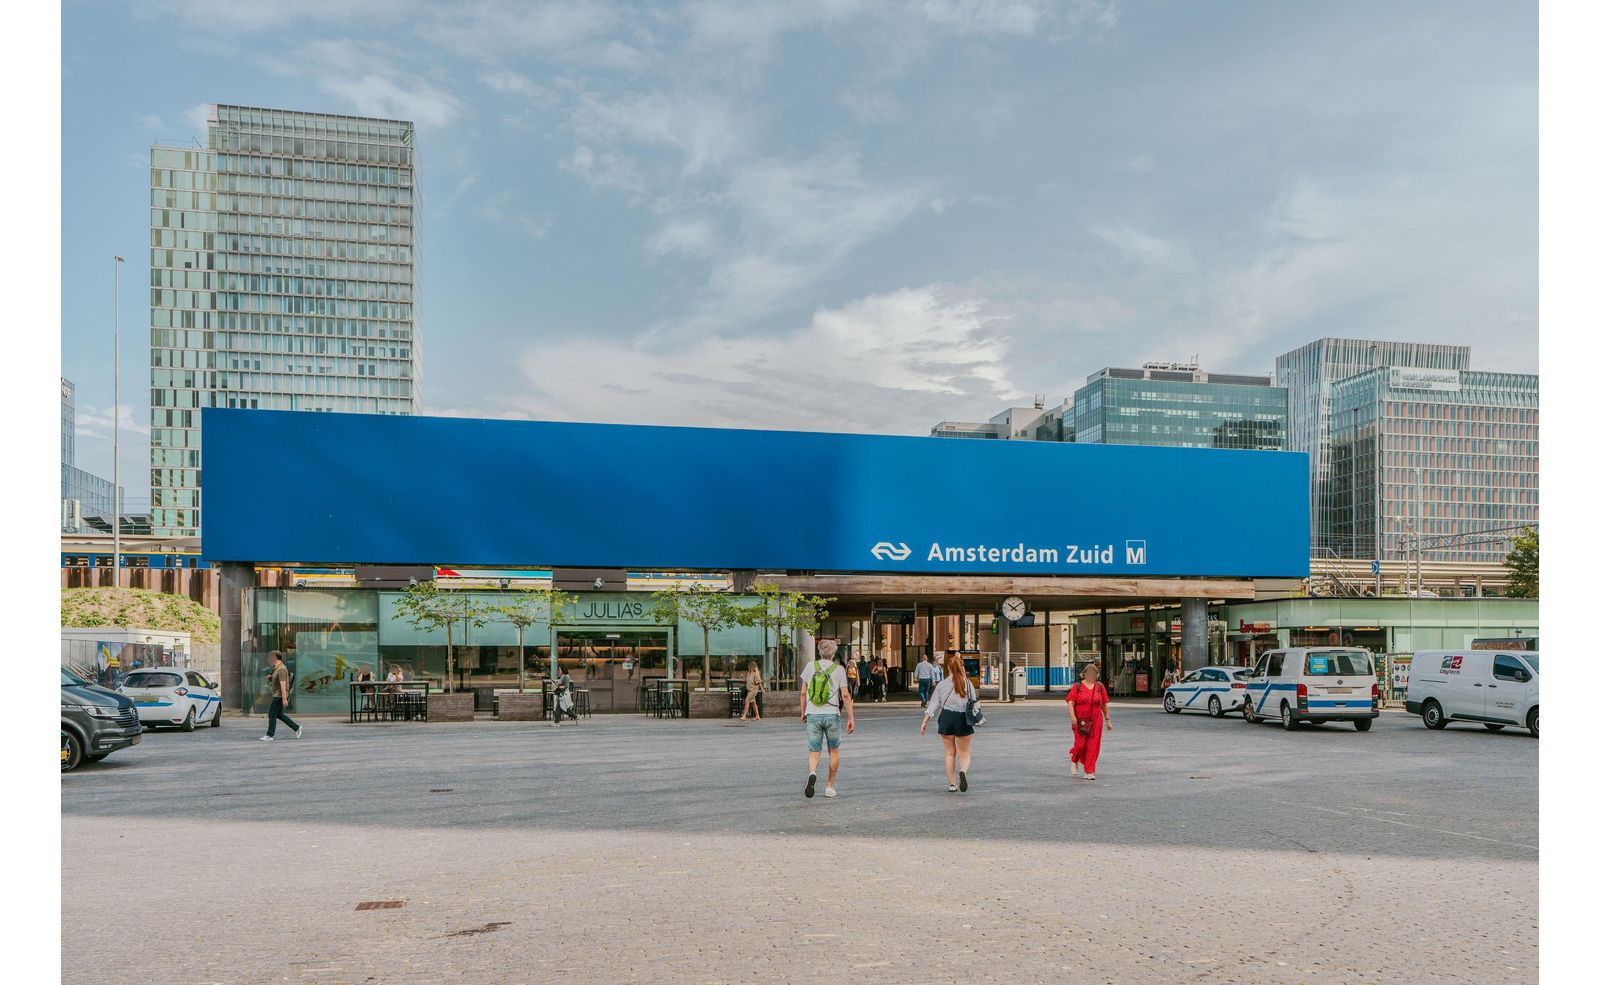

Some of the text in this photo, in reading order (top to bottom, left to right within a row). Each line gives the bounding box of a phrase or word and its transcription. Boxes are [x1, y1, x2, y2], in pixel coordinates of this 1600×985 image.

[927, 543, 1146, 564] Amsterdam Zuid M
[584, 602, 643, 618] JULIA'S
